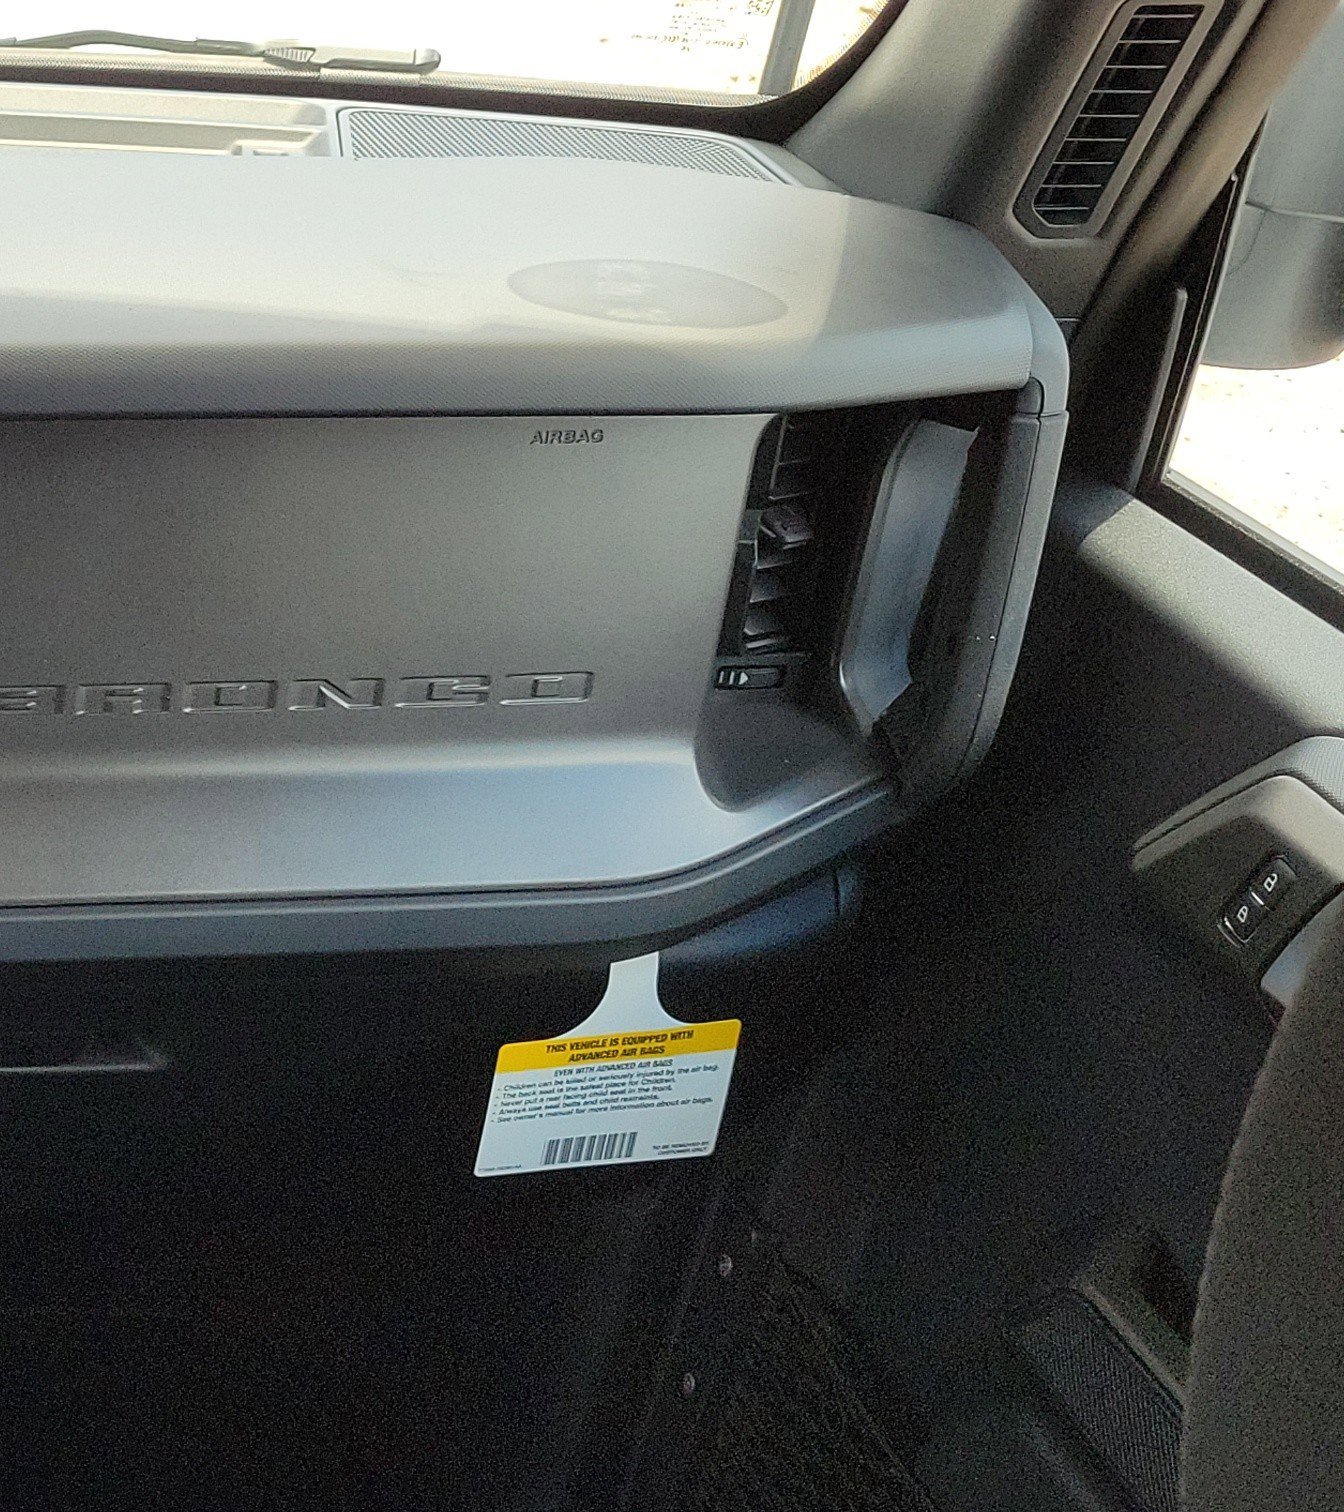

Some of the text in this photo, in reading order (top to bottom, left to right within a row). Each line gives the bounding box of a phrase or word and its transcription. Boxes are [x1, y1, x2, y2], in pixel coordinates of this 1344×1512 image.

[530, 429, 604, 444] AIRBAG
[545, 1029, 694, 1053] THIS VEHICLE IS EQUIPPED WITH
[567, 1044, 666, 1063] ADVANCED AIR BAGS
[553, 1058, 673, 1077] EVEN WITH ADVANCED AIR BAGS
[501, 1091, 516, 1099] The
